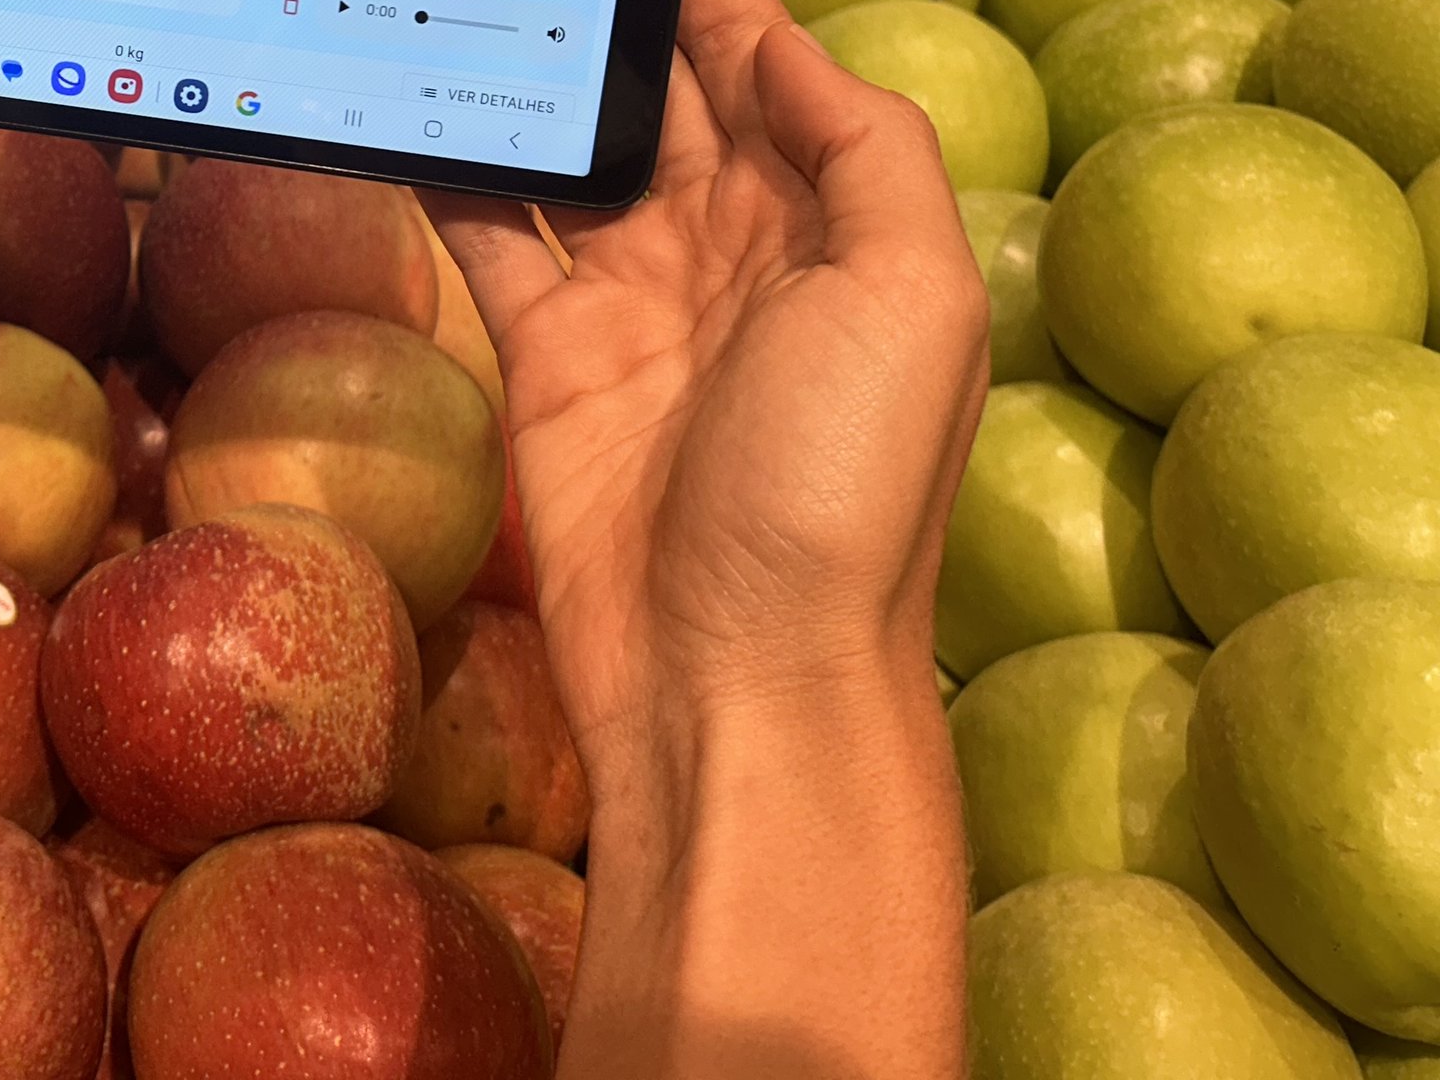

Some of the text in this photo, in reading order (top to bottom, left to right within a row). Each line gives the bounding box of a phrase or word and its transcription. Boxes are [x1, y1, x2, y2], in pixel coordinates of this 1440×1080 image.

[366, 4, 397, 18] 0:00
[115, 45, 144, 62] 0 kg
[448, 88, 556, 114] VER DETALHES
